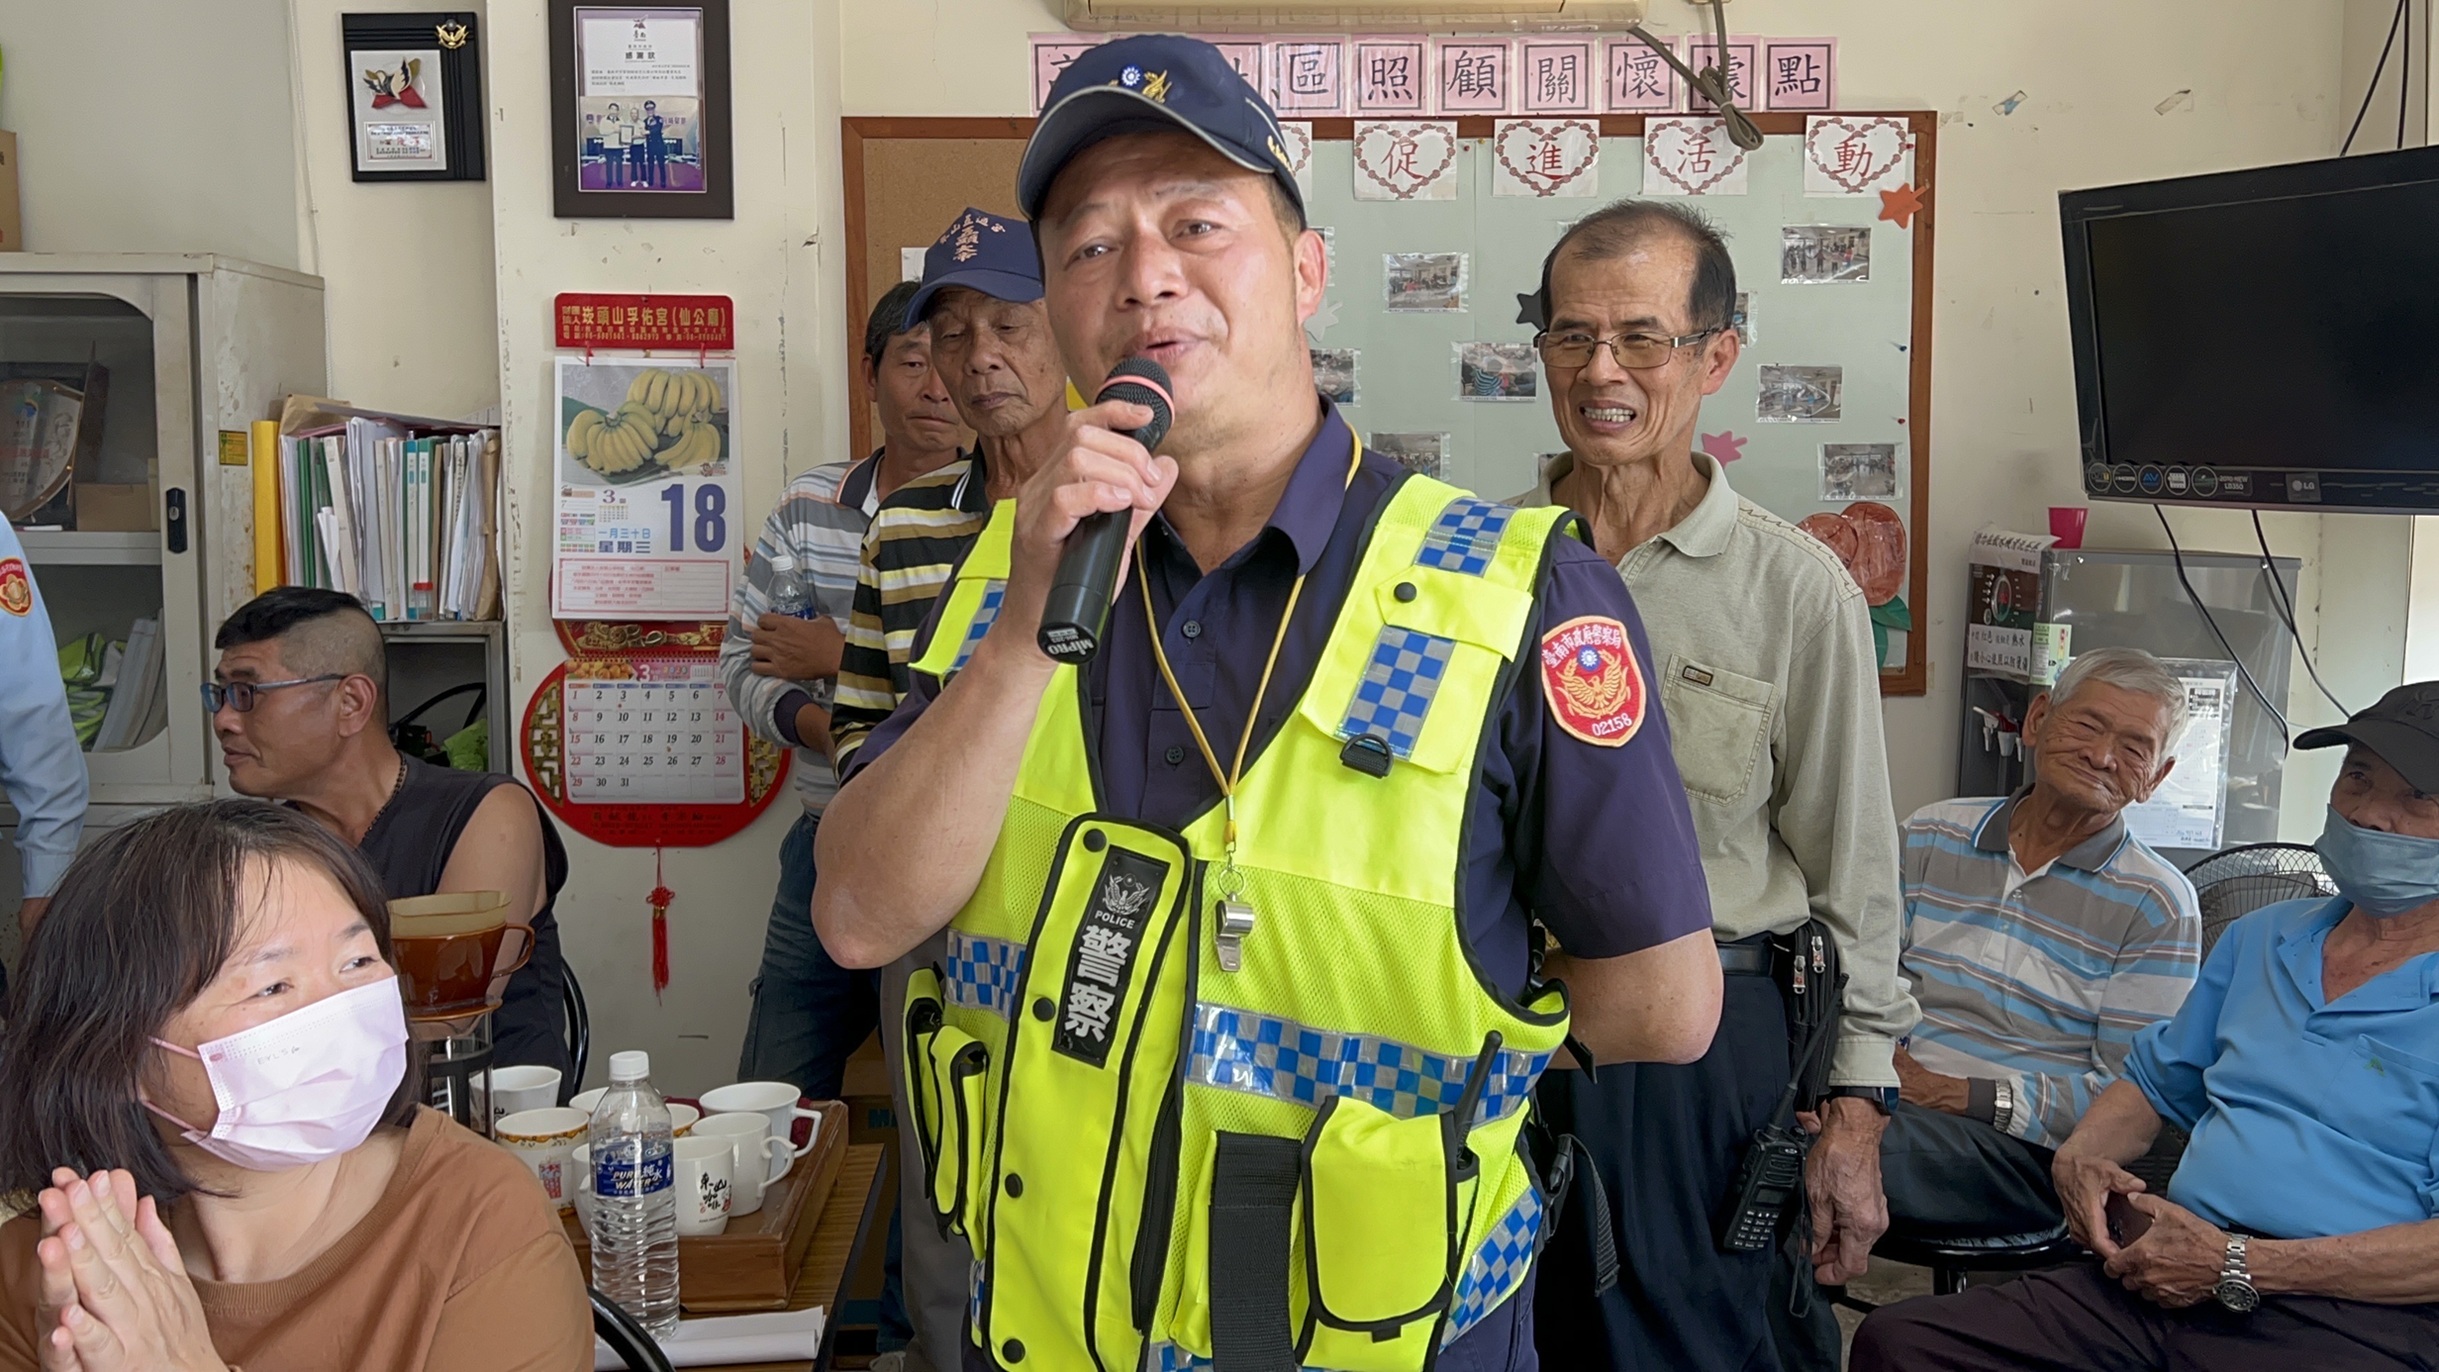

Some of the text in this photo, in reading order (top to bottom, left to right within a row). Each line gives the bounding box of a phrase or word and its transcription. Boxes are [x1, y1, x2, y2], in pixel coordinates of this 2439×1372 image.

[2142, 472, 2159, 481] AV
[2303, 482, 2315, 490] LG
[602, 489, 616, 504] 3
[660, 483, 727, 553] 18
[598, 527, 651, 539] 一月三十日
[598, 540, 651, 554] 星期三
[1542, 624, 1622, 668] 臺南市政府警察局
[638, 664, 650, 682] 3
[573, 690, 724, 700] 1 2 3 4 5 6 7
[572, 712, 725, 722] 8 9 10 11 12 13 14
[1591, 713, 1632, 736] 02158
[572, 734, 725, 743] 15 16 17 18 19 20 21
[572, 756, 726, 765] 22 23 24 25 26 27 28
[573, 778, 629, 787] 29 30 31
[1094, 910, 1136, 929] POLICE
[1064, 924, 1132, 1044] 警察
[615, 1177, 651, 1190] WAER
